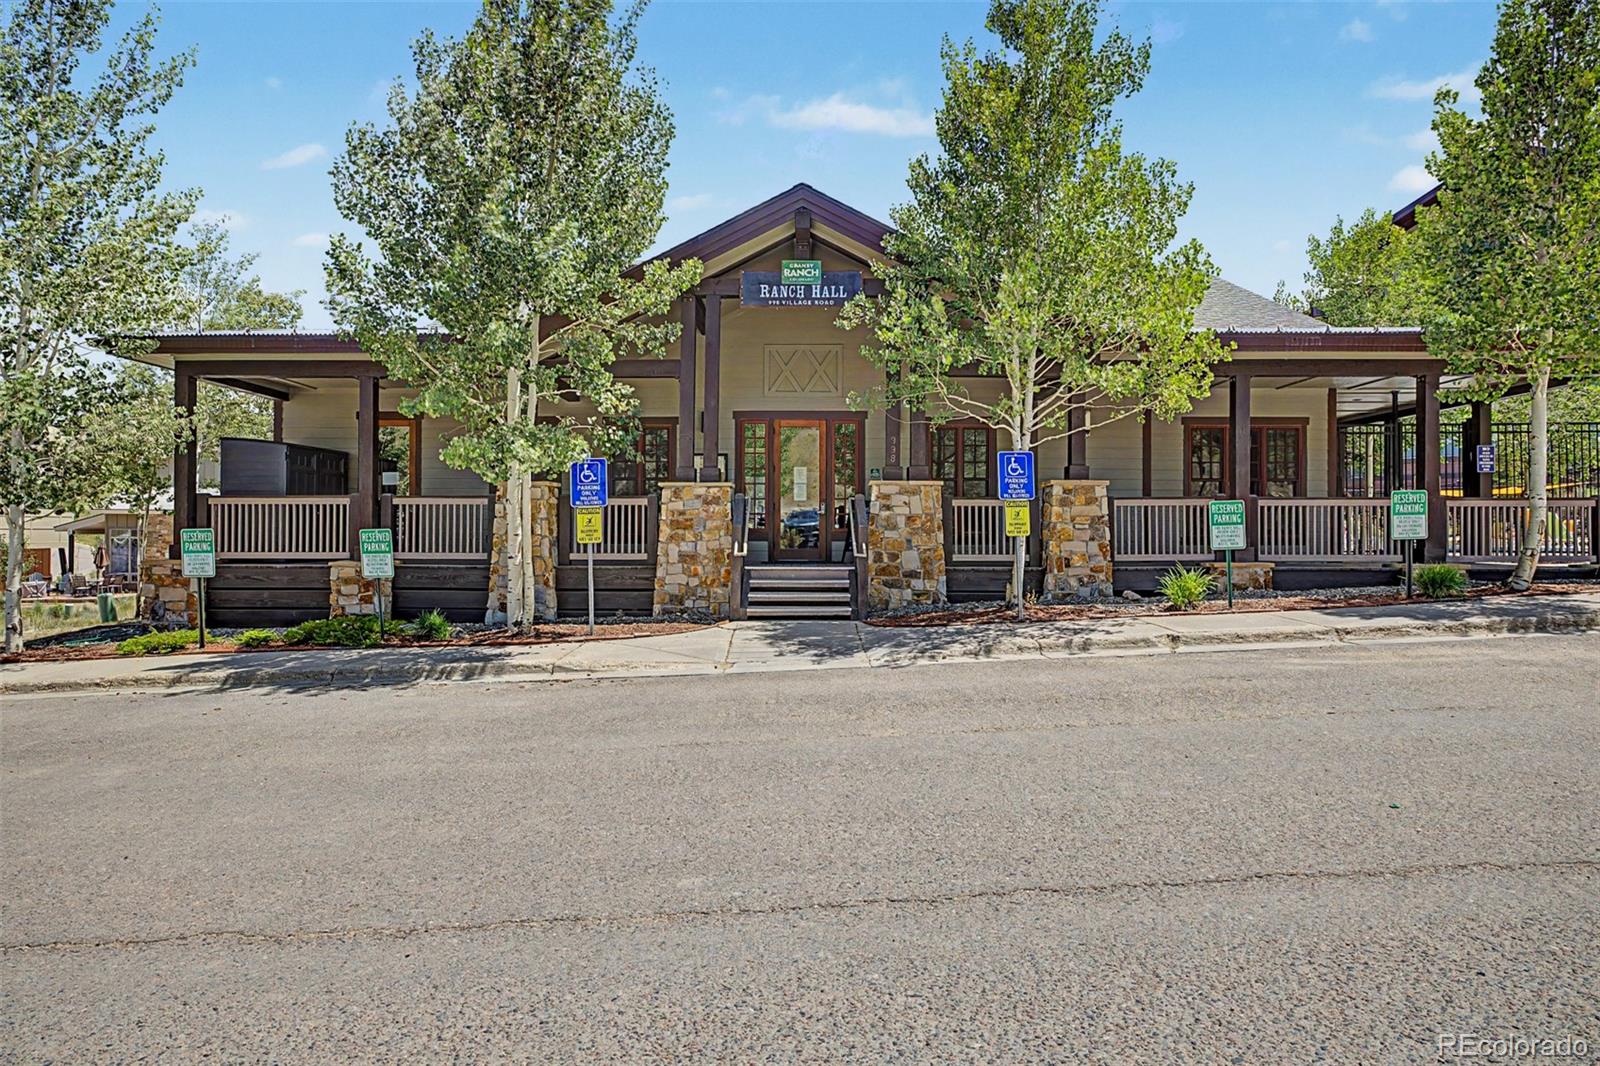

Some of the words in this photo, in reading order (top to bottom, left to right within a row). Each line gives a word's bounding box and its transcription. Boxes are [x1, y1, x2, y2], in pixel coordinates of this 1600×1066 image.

[784, 269, 819, 277] RANCH
[760, 284, 805, 298] RANCH
[812, 284, 847, 298] HALL
[1394, 494, 1426, 504] RESERVED
[1212, 504, 1242, 513] RESERVED
[1396, 504, 1424, 513] PARKING
[1214, 514, 1242, 524] PARKING
[183, 532, 212, 541] RESERVED
[362, 532, 390, 542] RESERVED
[185, 542, 211, 552] PARKING
[364, 542, 389, 552] PARKING
